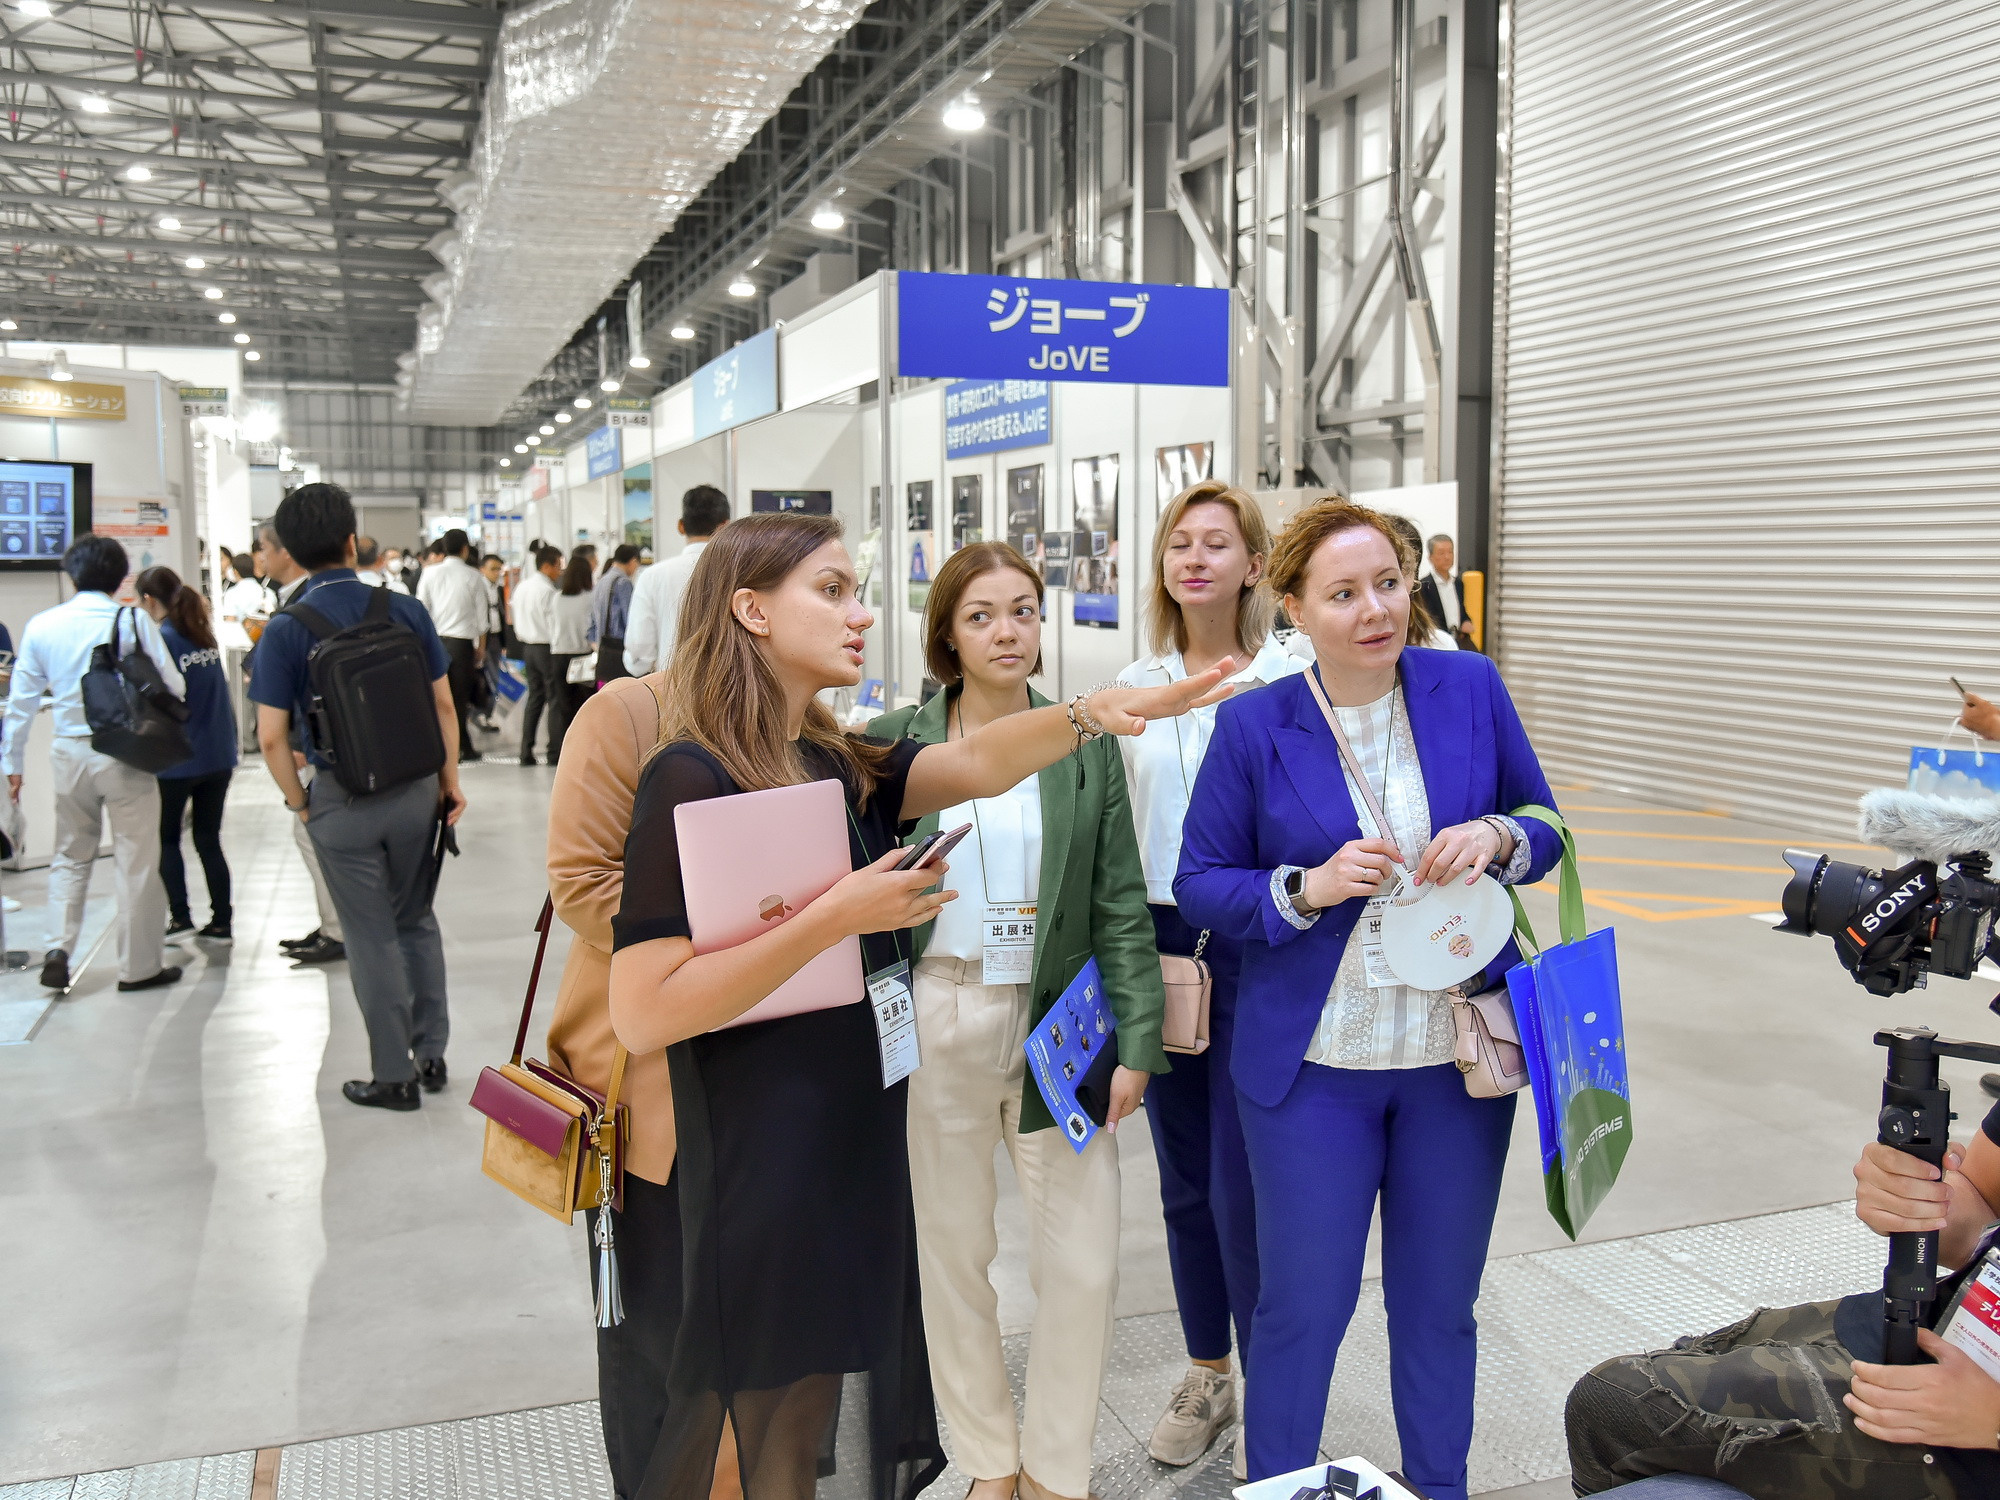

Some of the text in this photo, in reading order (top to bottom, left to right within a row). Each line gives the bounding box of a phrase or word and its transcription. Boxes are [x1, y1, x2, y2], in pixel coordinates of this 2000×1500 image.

[987, 286, 1150, 338] ジョーブ
[1028, 344, 1110, 373] JoVE
[612, 415, 649, 426] B1-48
[1018, 907, 1038, 915] VIP
[1861, 873, 1926, 933] SONY
[992, 923, 1034, 936] 出展社
[1429, 914, 1462, 942] ELMO
[882, 996, 909, 1023] 出展社
[1583, 1115, 1623, 1156] SYSTEMS
[1917, 1237, 1926, 1264] RONIN
